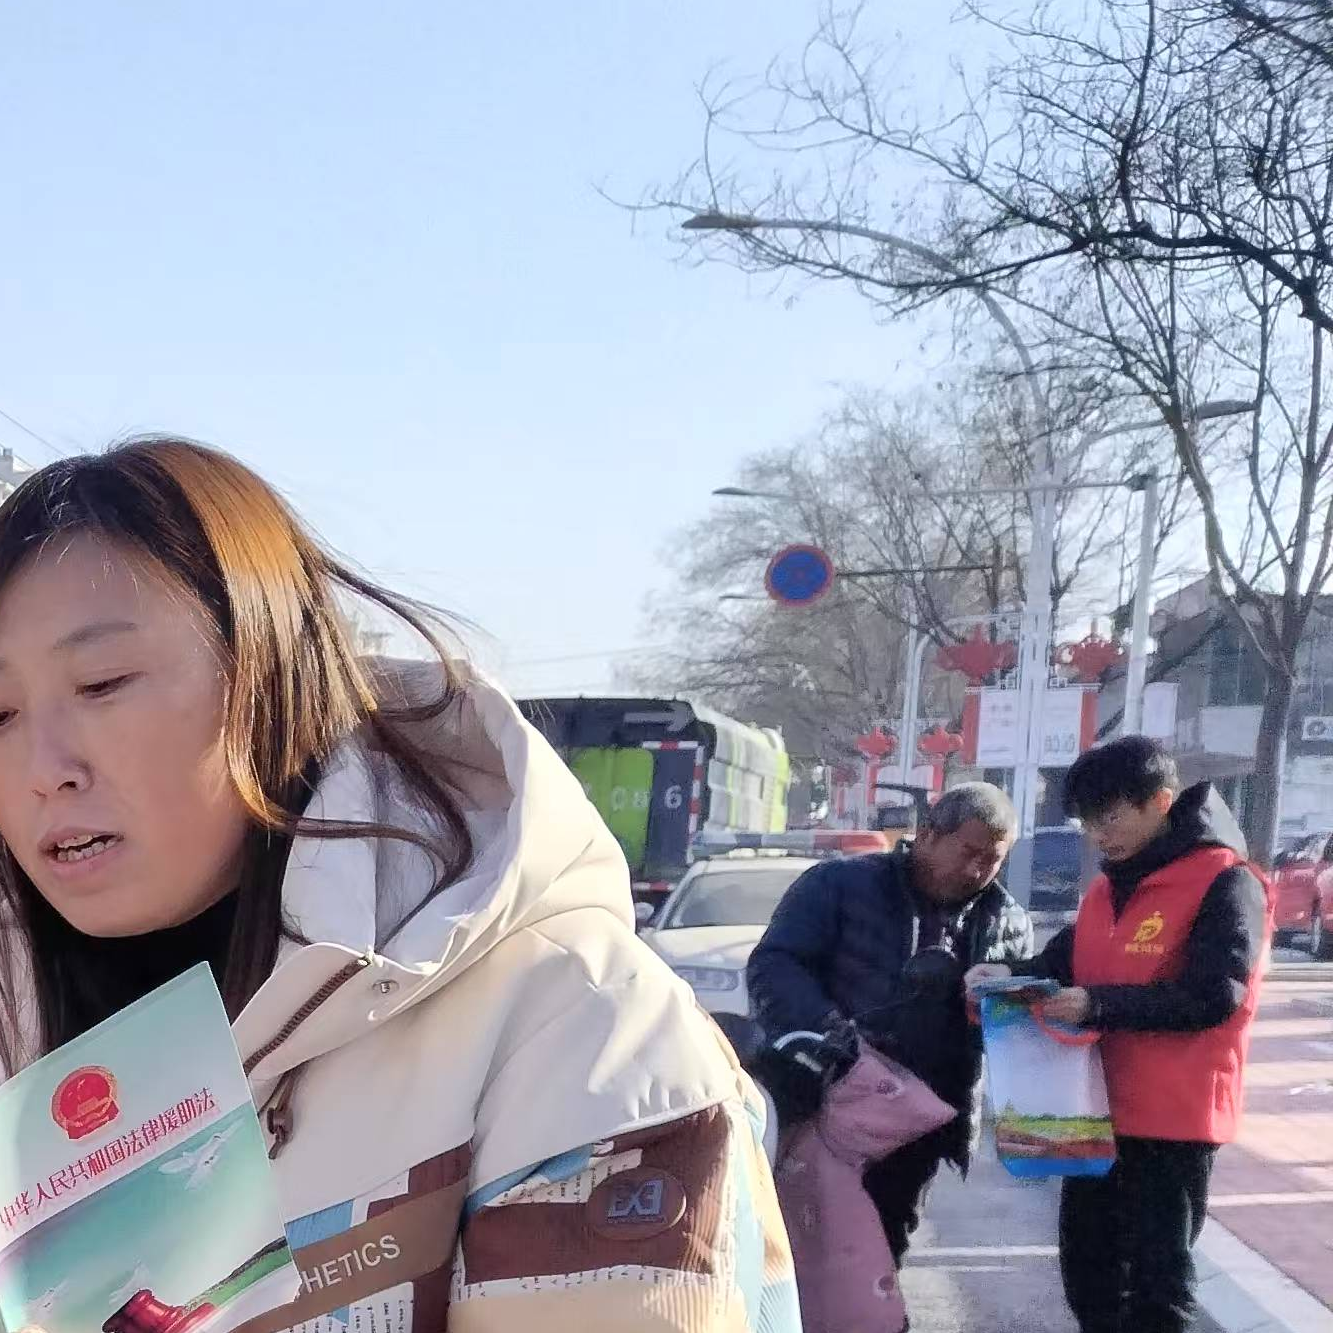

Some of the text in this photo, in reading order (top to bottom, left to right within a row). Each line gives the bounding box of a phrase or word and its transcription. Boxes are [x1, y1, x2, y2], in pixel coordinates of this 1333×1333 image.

[0, 1087, 215, 1226] 中华人民共和国法律援助法
